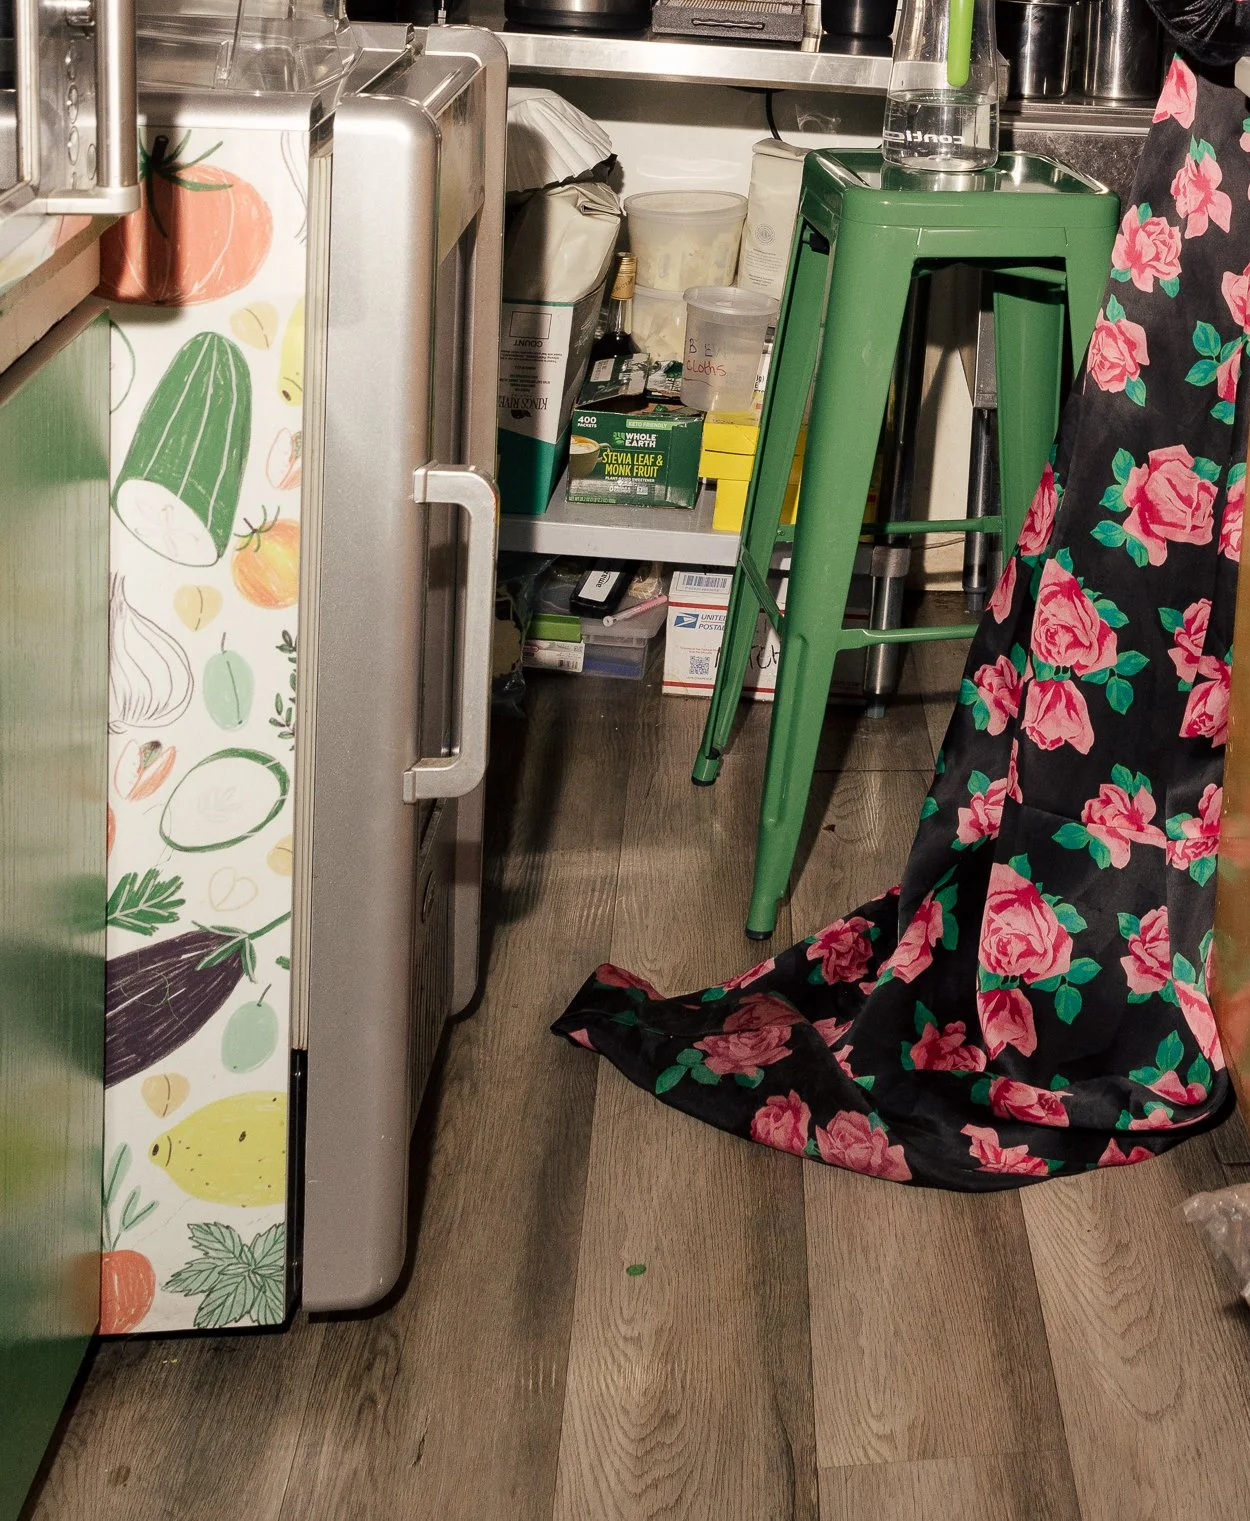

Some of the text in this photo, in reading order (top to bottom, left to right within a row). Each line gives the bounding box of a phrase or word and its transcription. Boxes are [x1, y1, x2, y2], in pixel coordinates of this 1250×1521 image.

[513, 340, 543, 348] COUNT
[577, 416, 597, 424] 400
[625, 432, 657, 441] WHOLE
[625, 440, 656, 448] EARTH
[602, 452, 663, 466] STEVIA LEAF &
[605, 464, 658, 477] MONK FRUIT
